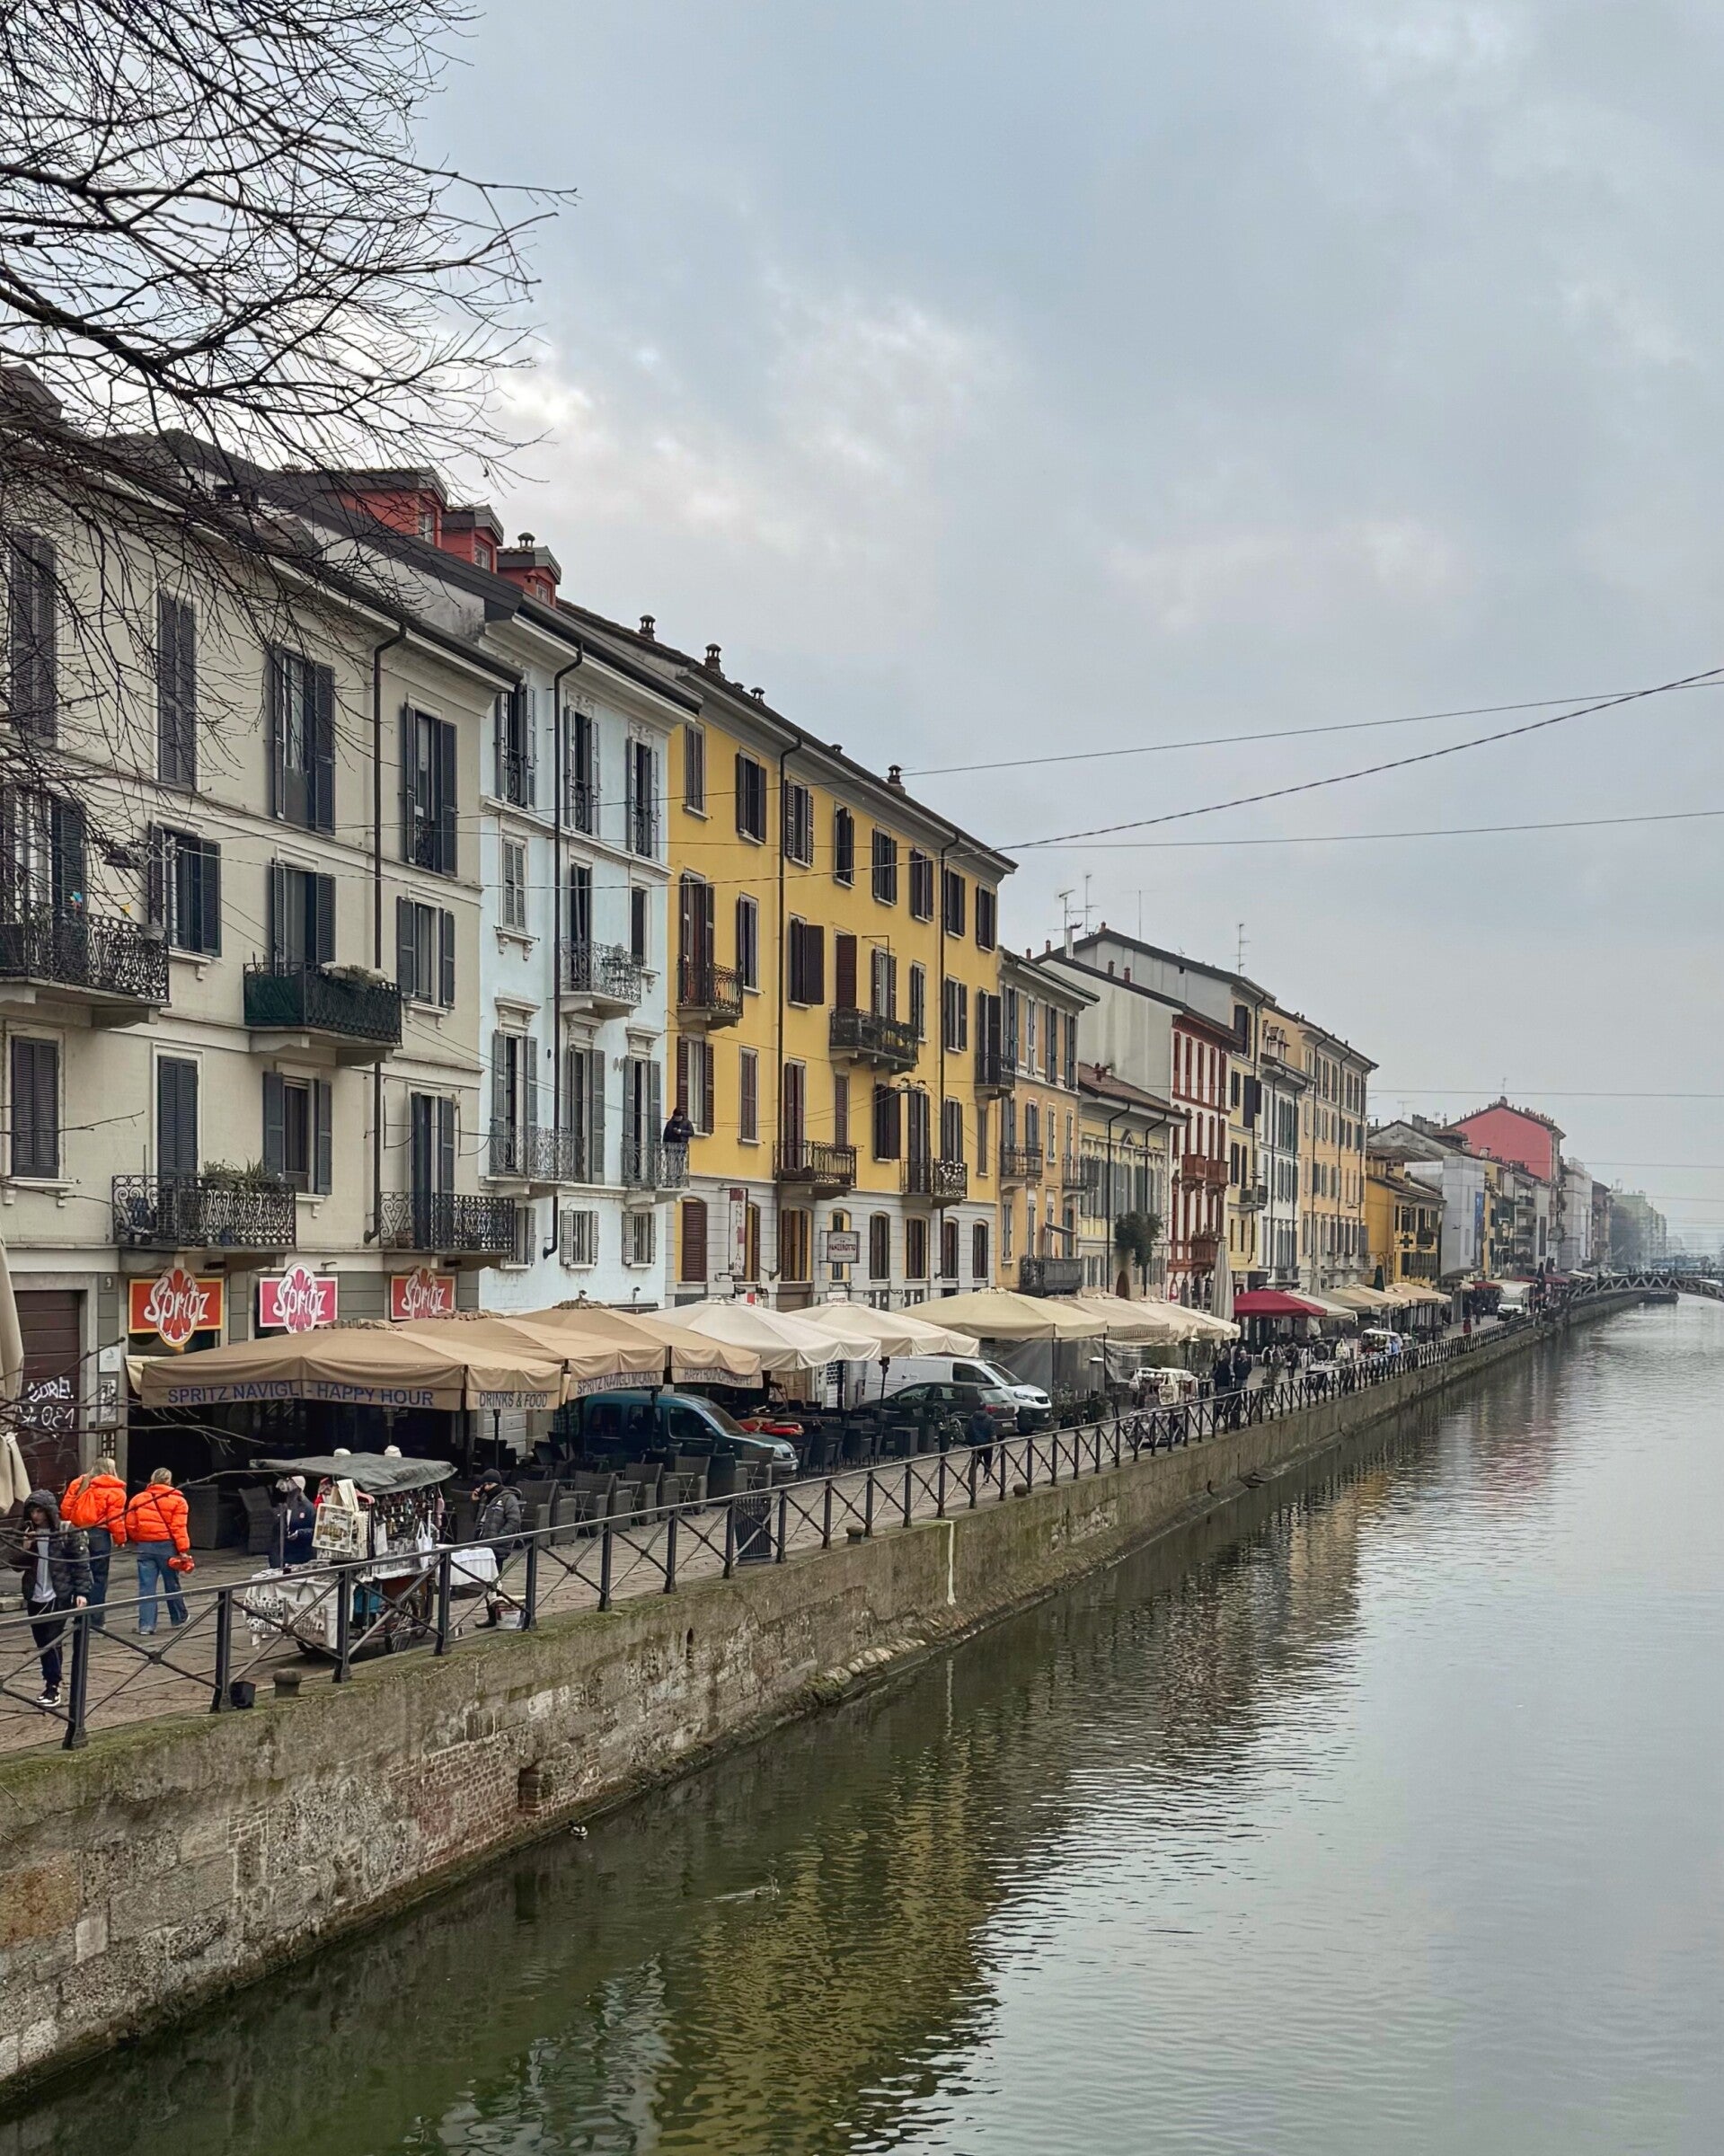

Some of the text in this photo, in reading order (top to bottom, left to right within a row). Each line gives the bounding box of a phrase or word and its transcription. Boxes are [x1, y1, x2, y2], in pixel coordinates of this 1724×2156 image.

[144, 1277, 210, 1324] Spritz
[273, 1274, 327, 1321] Spritz
[402, 1274, 446, 1317] Spritz
[168, 1386, 229, 1403] SPRITZ
[317, 1383, 375, 1401] HAPPY
[381, 1389, 434, 1406] HOUR
[479, 1392, 548, 1408] DRINKS & FOOD
[577, 1378, 603, 1394] SPRITZ
